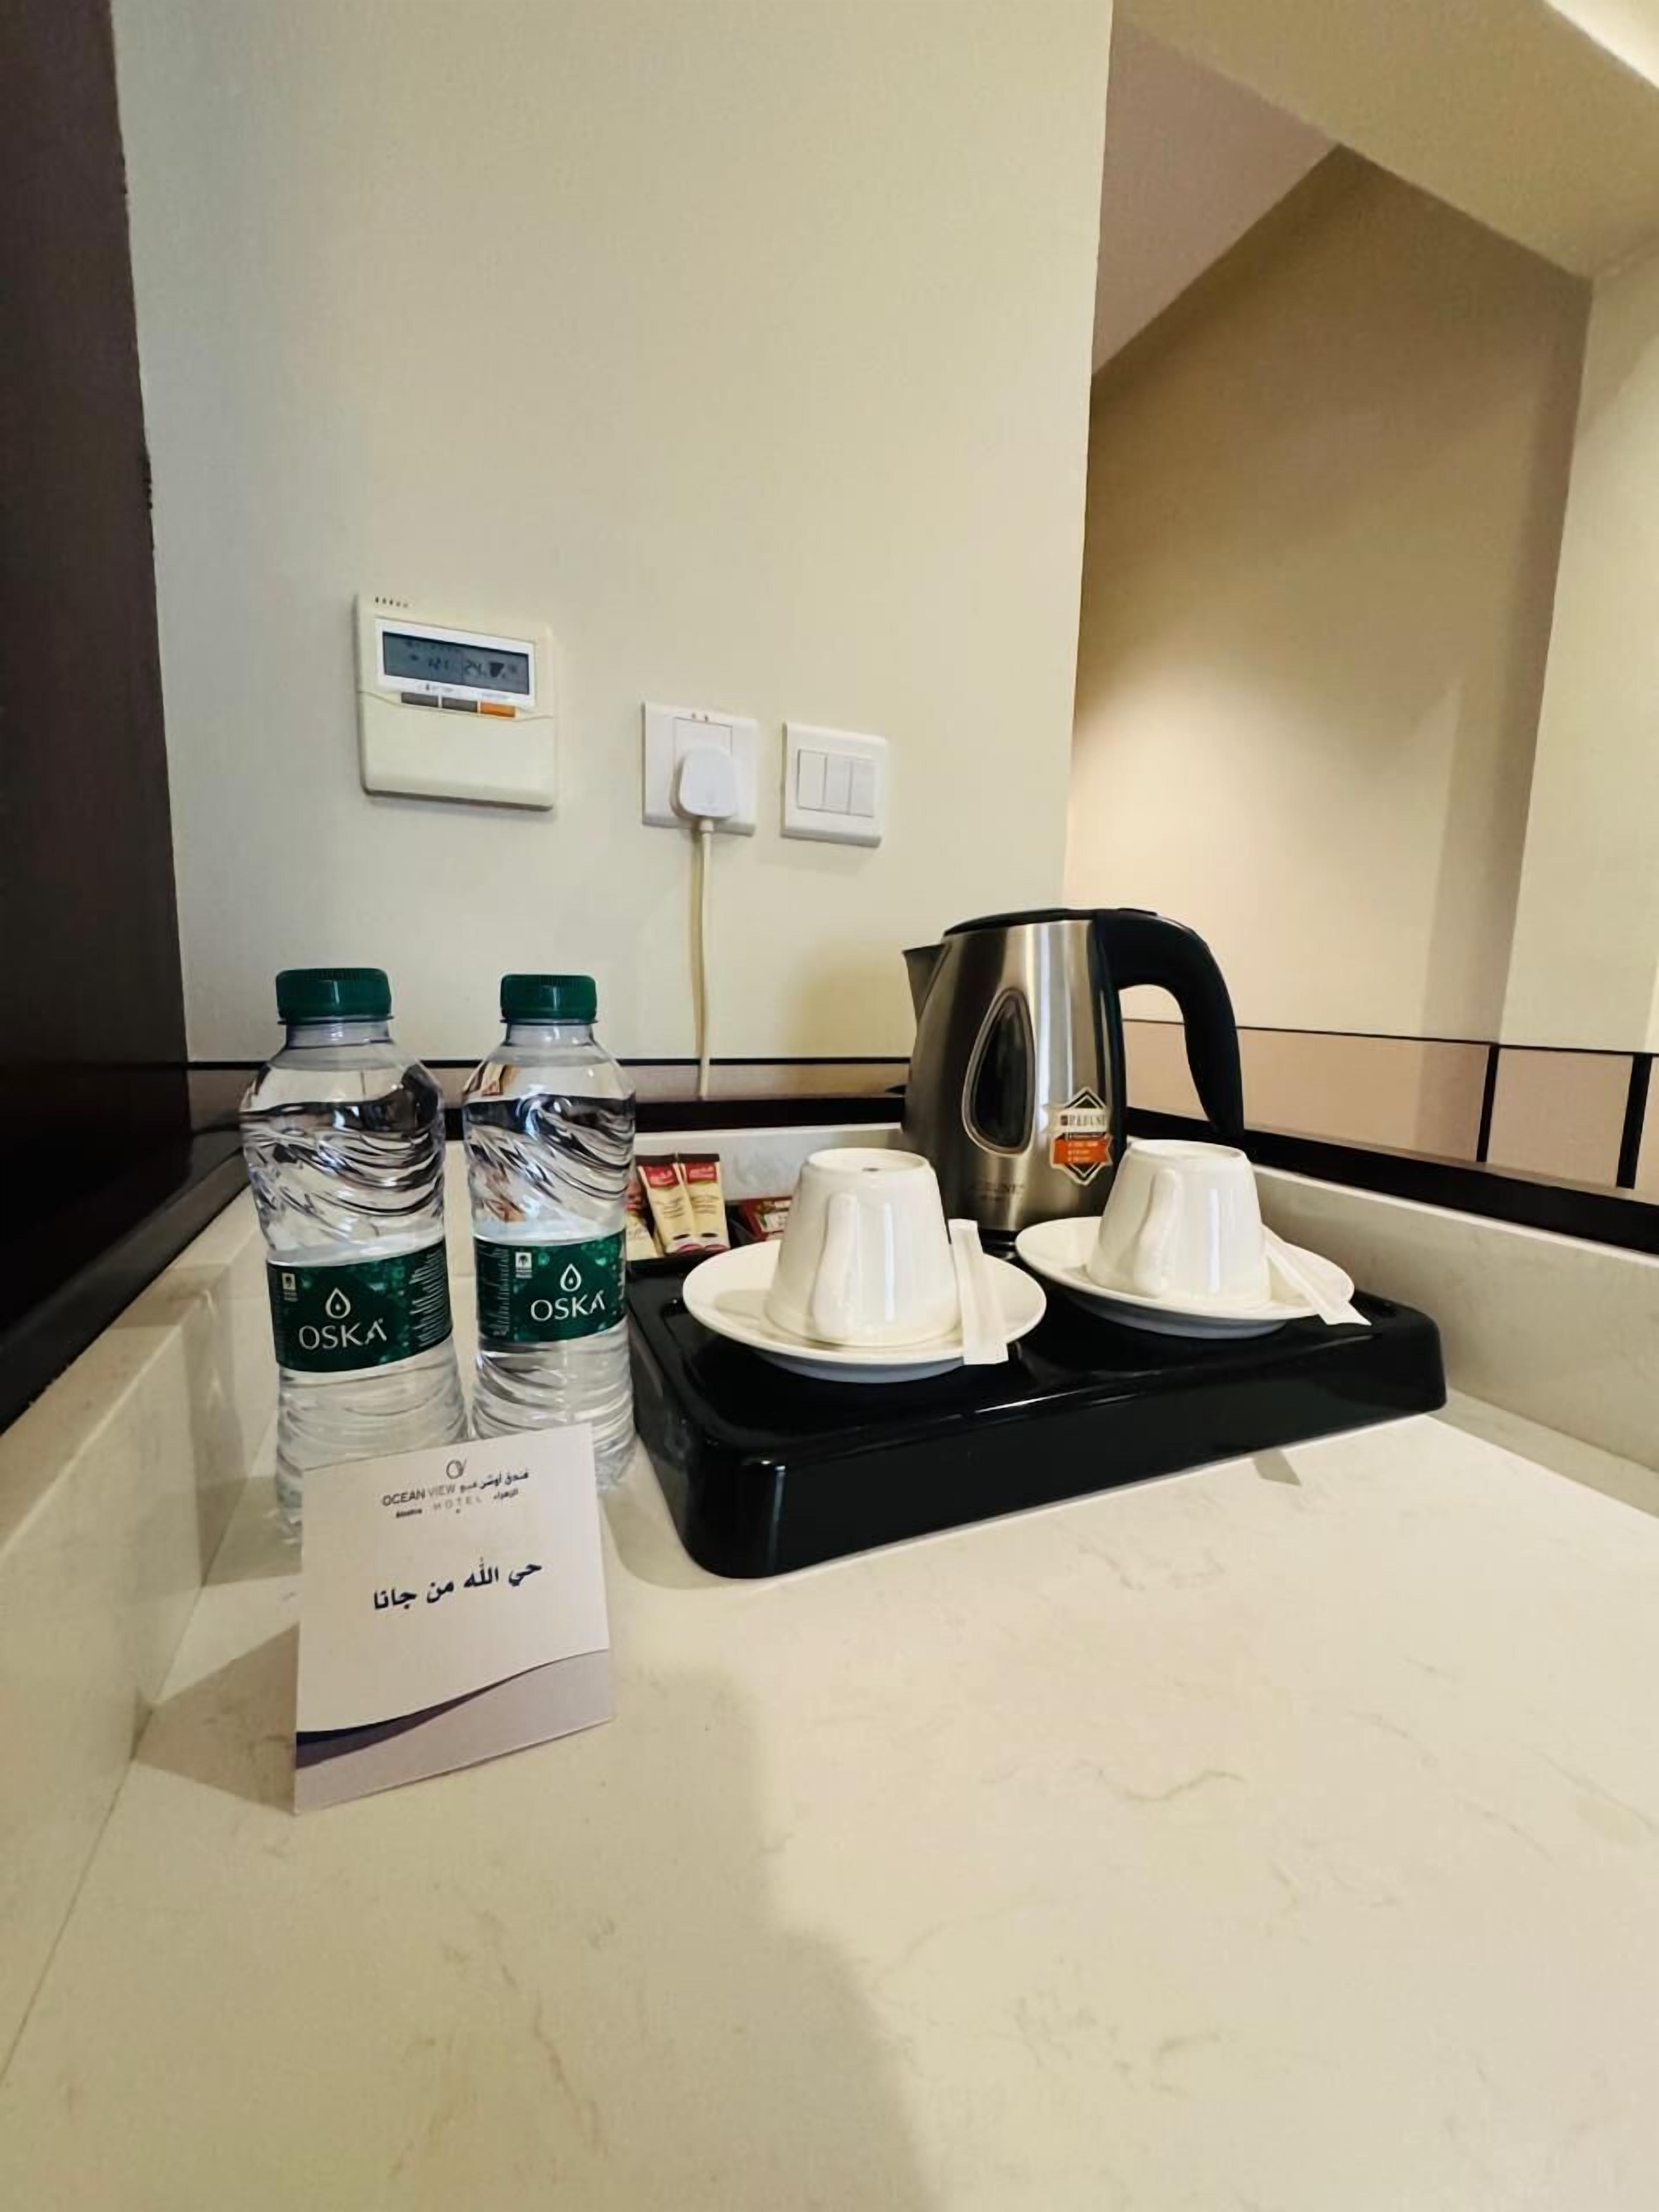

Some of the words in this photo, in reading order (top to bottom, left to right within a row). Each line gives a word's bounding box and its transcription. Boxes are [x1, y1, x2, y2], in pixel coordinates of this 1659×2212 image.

[382, 1489, 426, 1506] OCEAN
[427, 1484, 456, 1498] VIEW
[509, 1564, 543, 1586] حي
[426, 1581, 454, 1604] من
